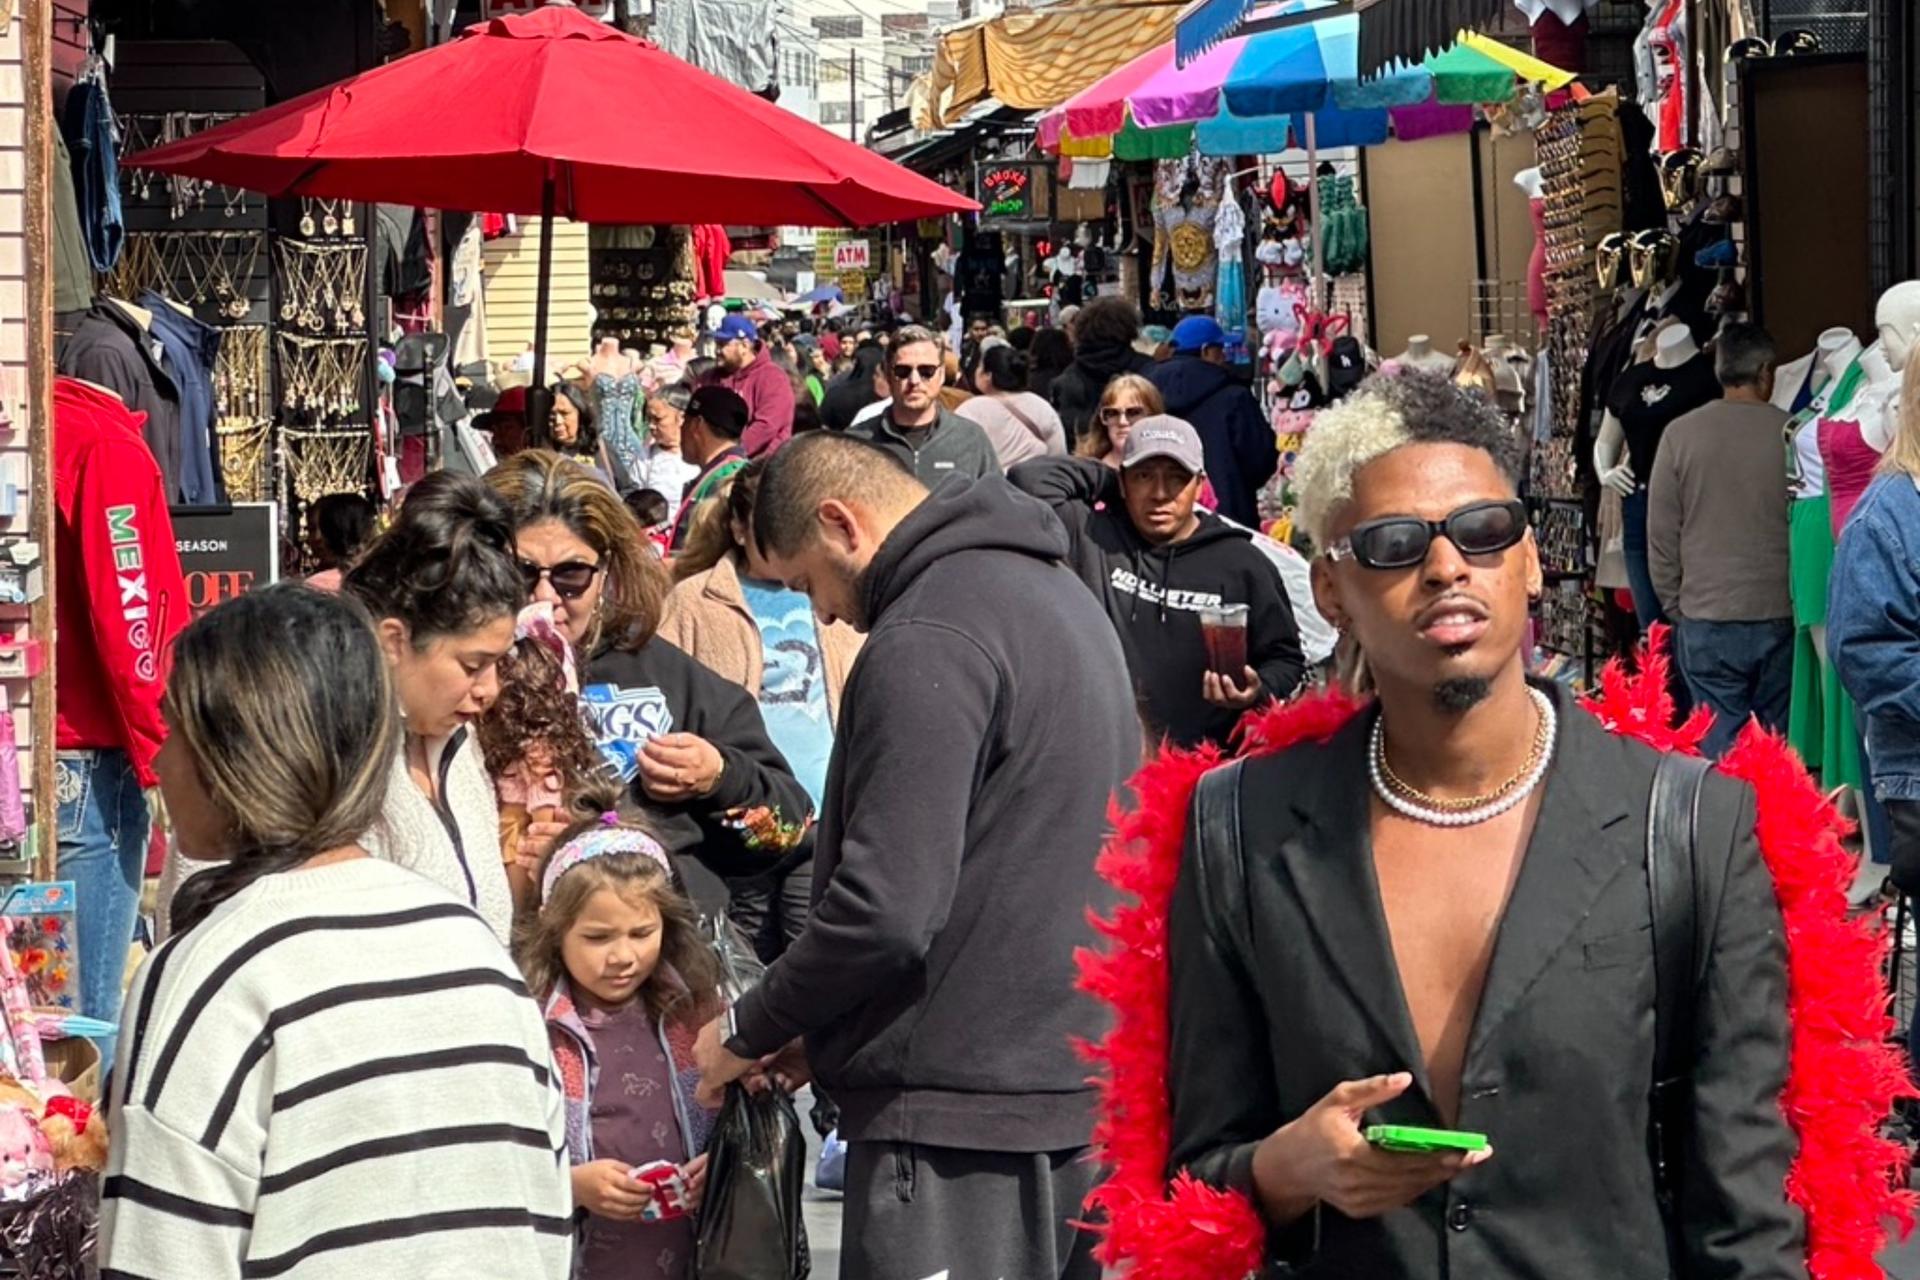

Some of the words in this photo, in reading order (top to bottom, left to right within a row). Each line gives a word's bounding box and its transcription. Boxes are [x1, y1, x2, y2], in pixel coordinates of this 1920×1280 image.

[984, 169, 1027, 187] SMOKE
[991, 199, 1023, 213] SHOP
[837, 247, 865, 263] ATM
[175, 540, 228, 552] SEASON
[106, 504, 158, 681] MEXICO
[185, 571, 254, 607] OFF
